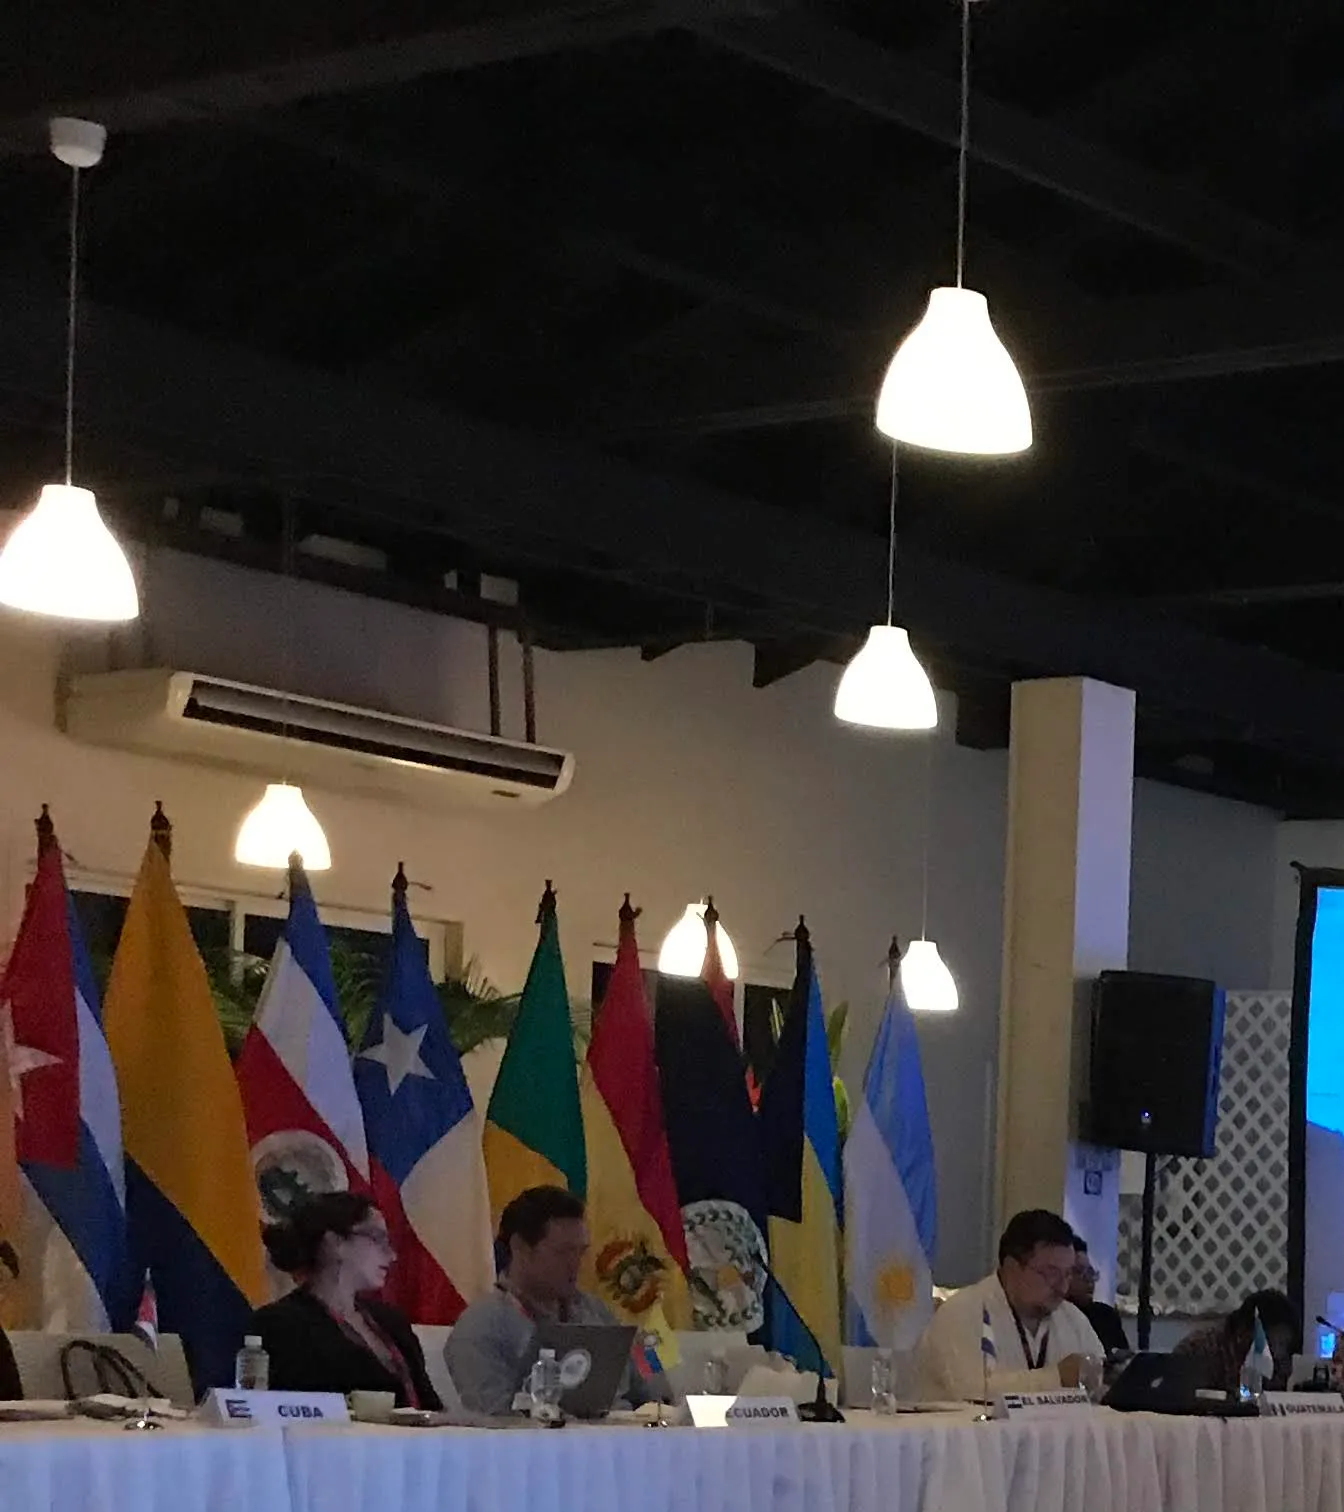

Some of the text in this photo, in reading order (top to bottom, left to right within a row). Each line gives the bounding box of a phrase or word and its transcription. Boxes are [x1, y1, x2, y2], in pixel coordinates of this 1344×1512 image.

[1021, 1395, 1088, 1405] EL SALVADOR
[277, 1405, 324, 1418] CUBA
